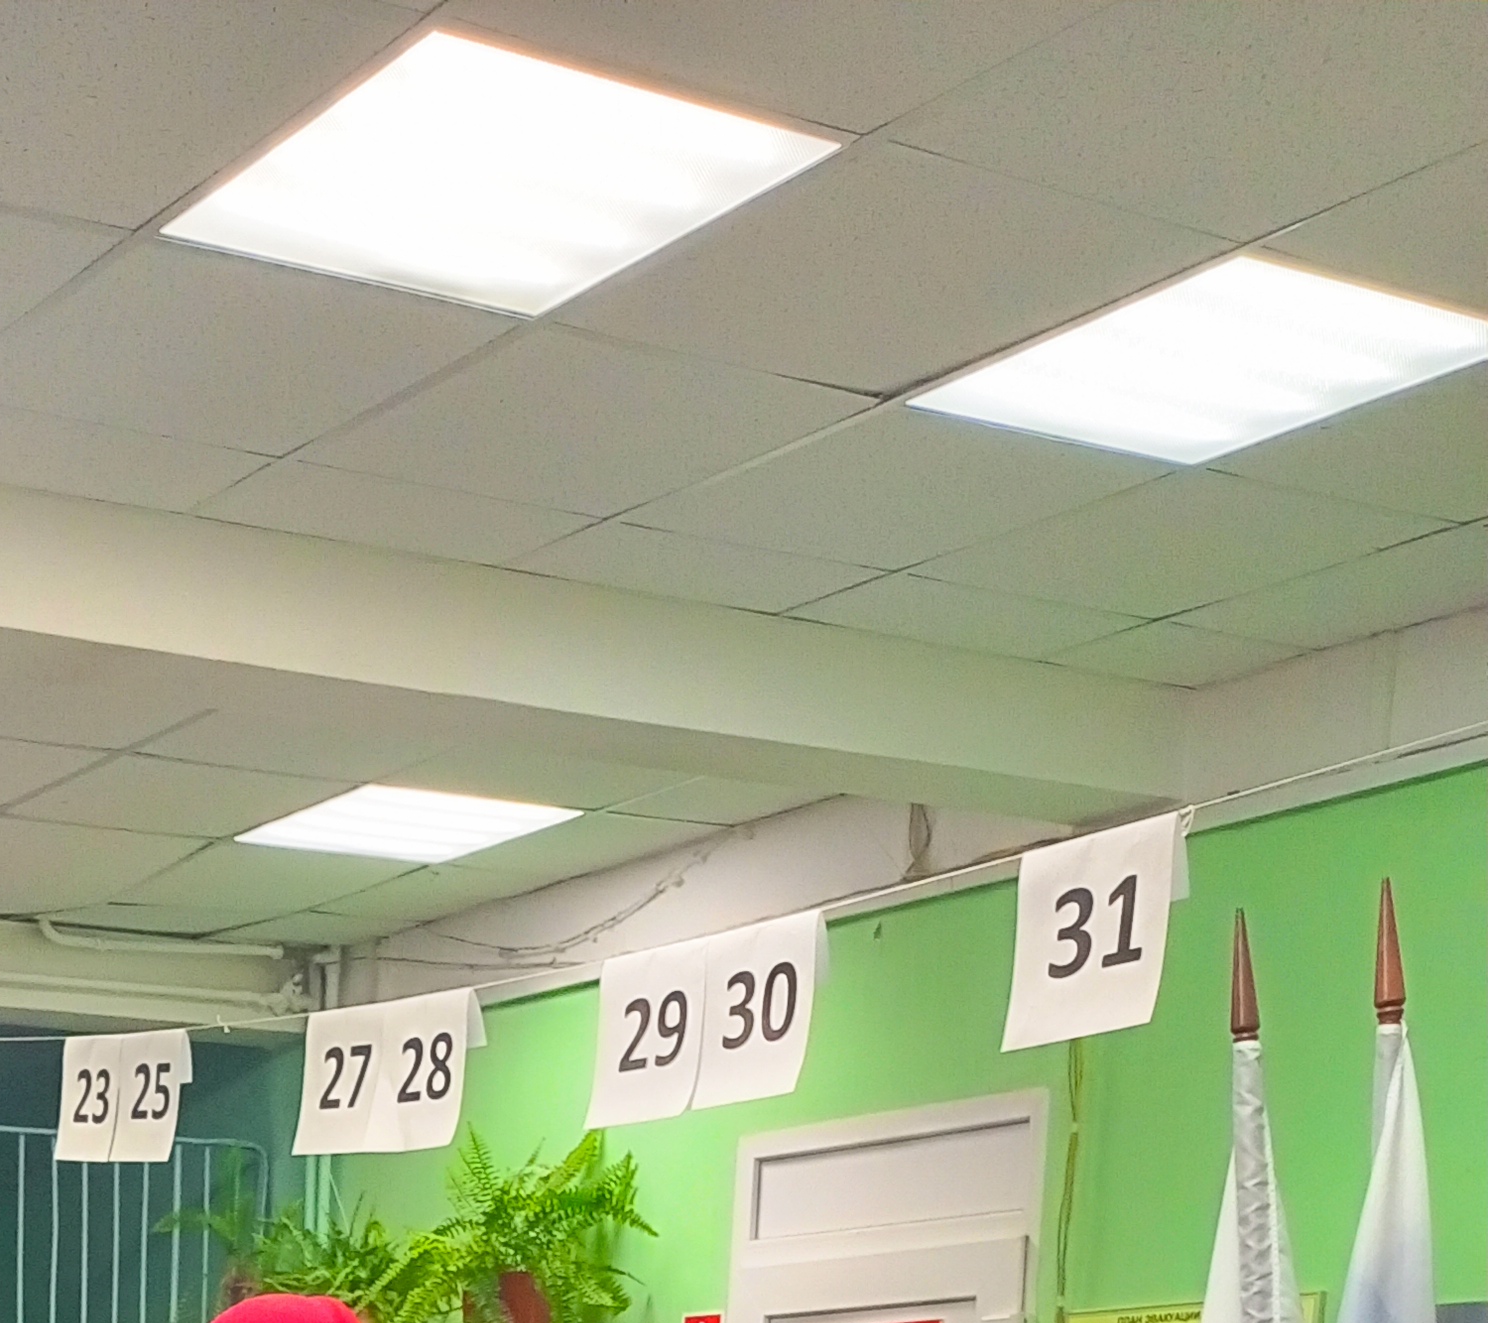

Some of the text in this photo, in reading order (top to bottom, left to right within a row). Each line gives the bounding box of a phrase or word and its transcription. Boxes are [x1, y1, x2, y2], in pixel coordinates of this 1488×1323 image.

[1047, 873, 1144, 980] 31
[617, 989, 689, 1074] 29
[720, 960, 799, 1051] 30
[73, 1068, 111, 1126] 23
[129, 1062, 171, 1121] 25
[317, 1042, 374, 1111] 27
[395, 1031, 455, 1105] 28
